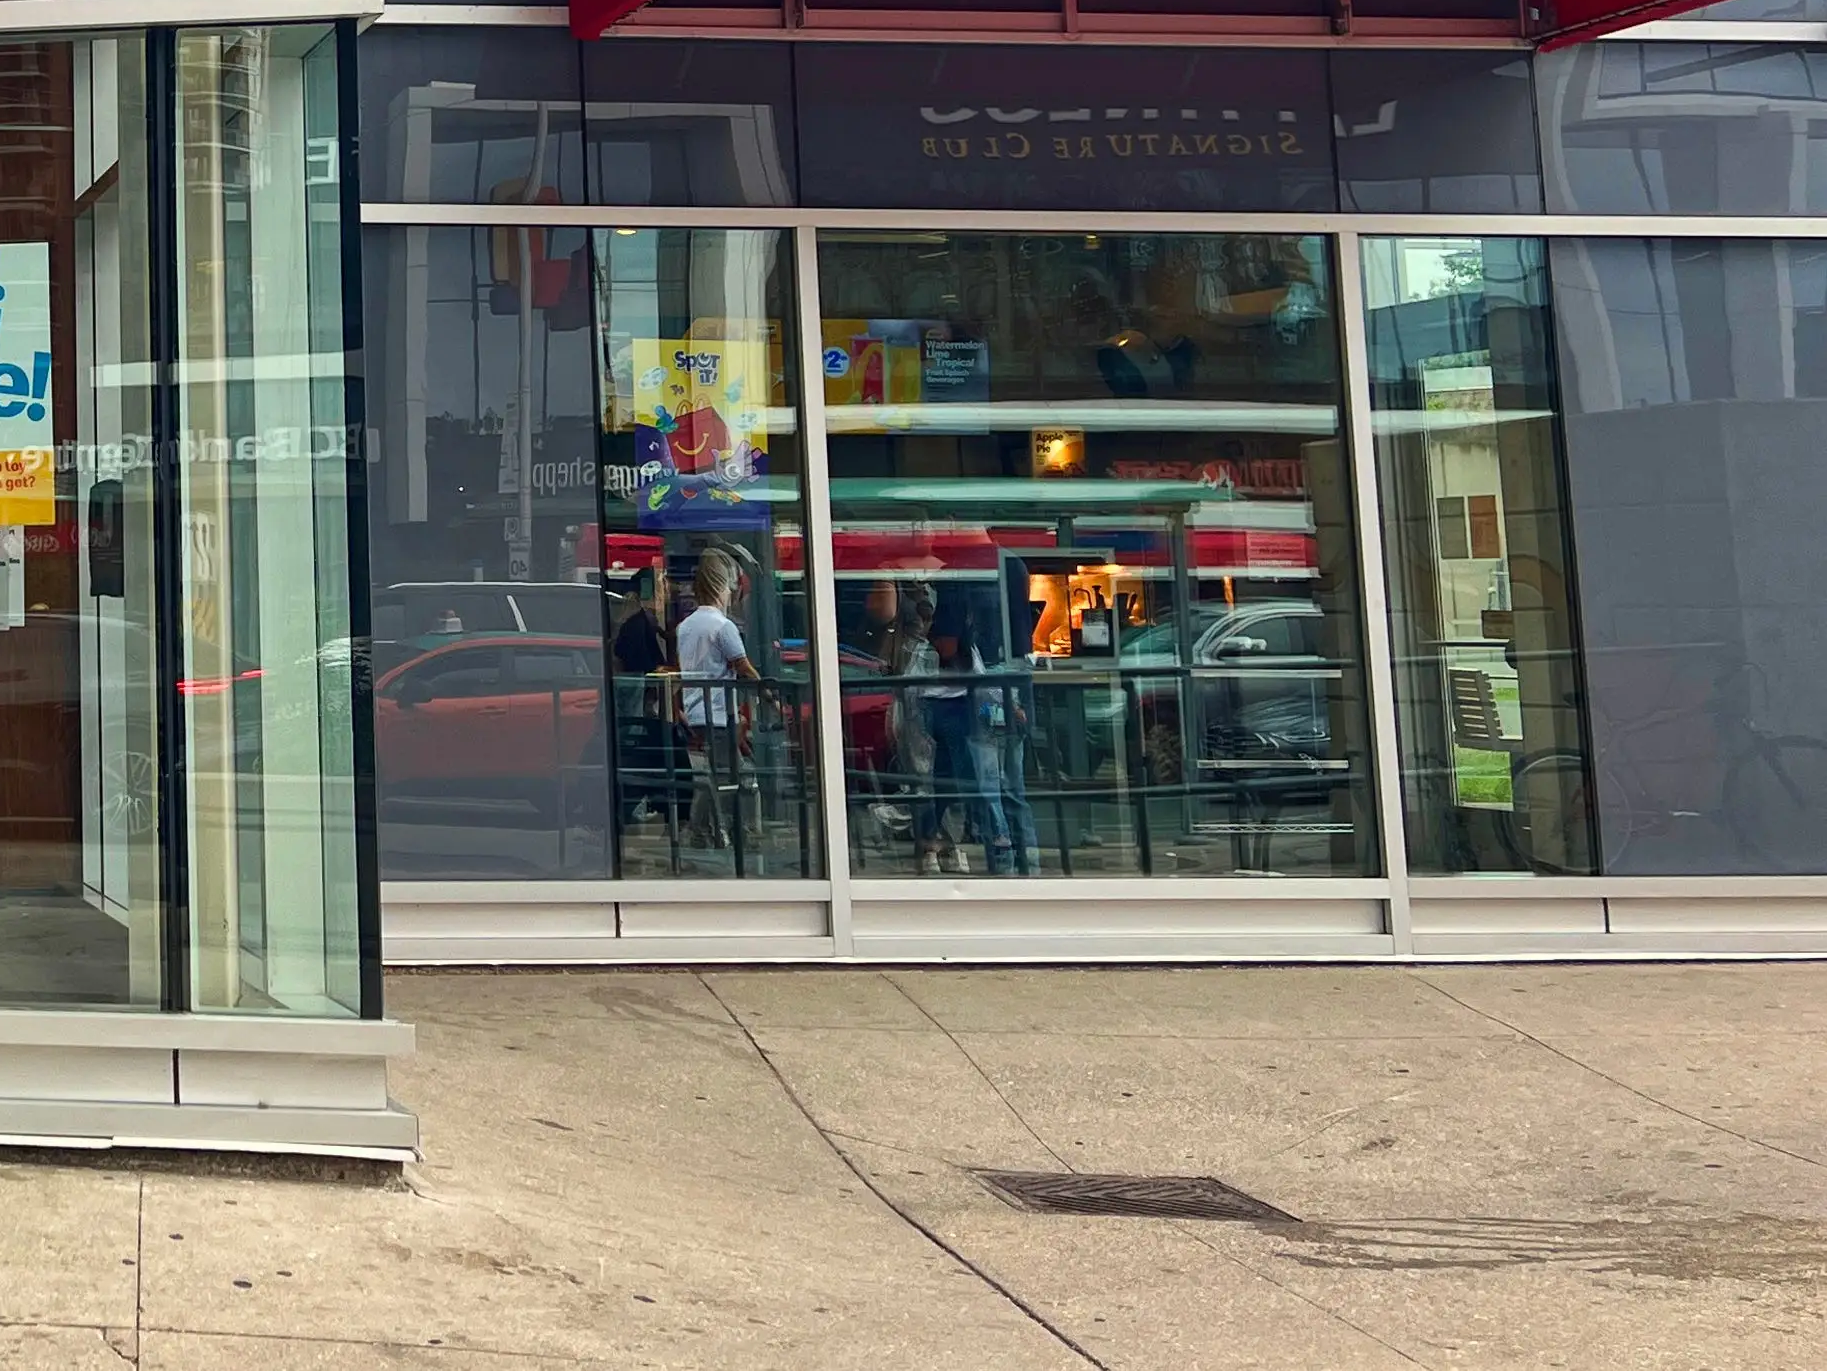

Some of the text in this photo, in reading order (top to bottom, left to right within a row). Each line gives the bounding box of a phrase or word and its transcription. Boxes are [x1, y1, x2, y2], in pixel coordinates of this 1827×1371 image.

[926, 340, 985, 350] Watermelon
[926, 350, 950, 359] Lime
[1036, 433, 1064, 444] Apple
[5, 460, 26, 476] toy
